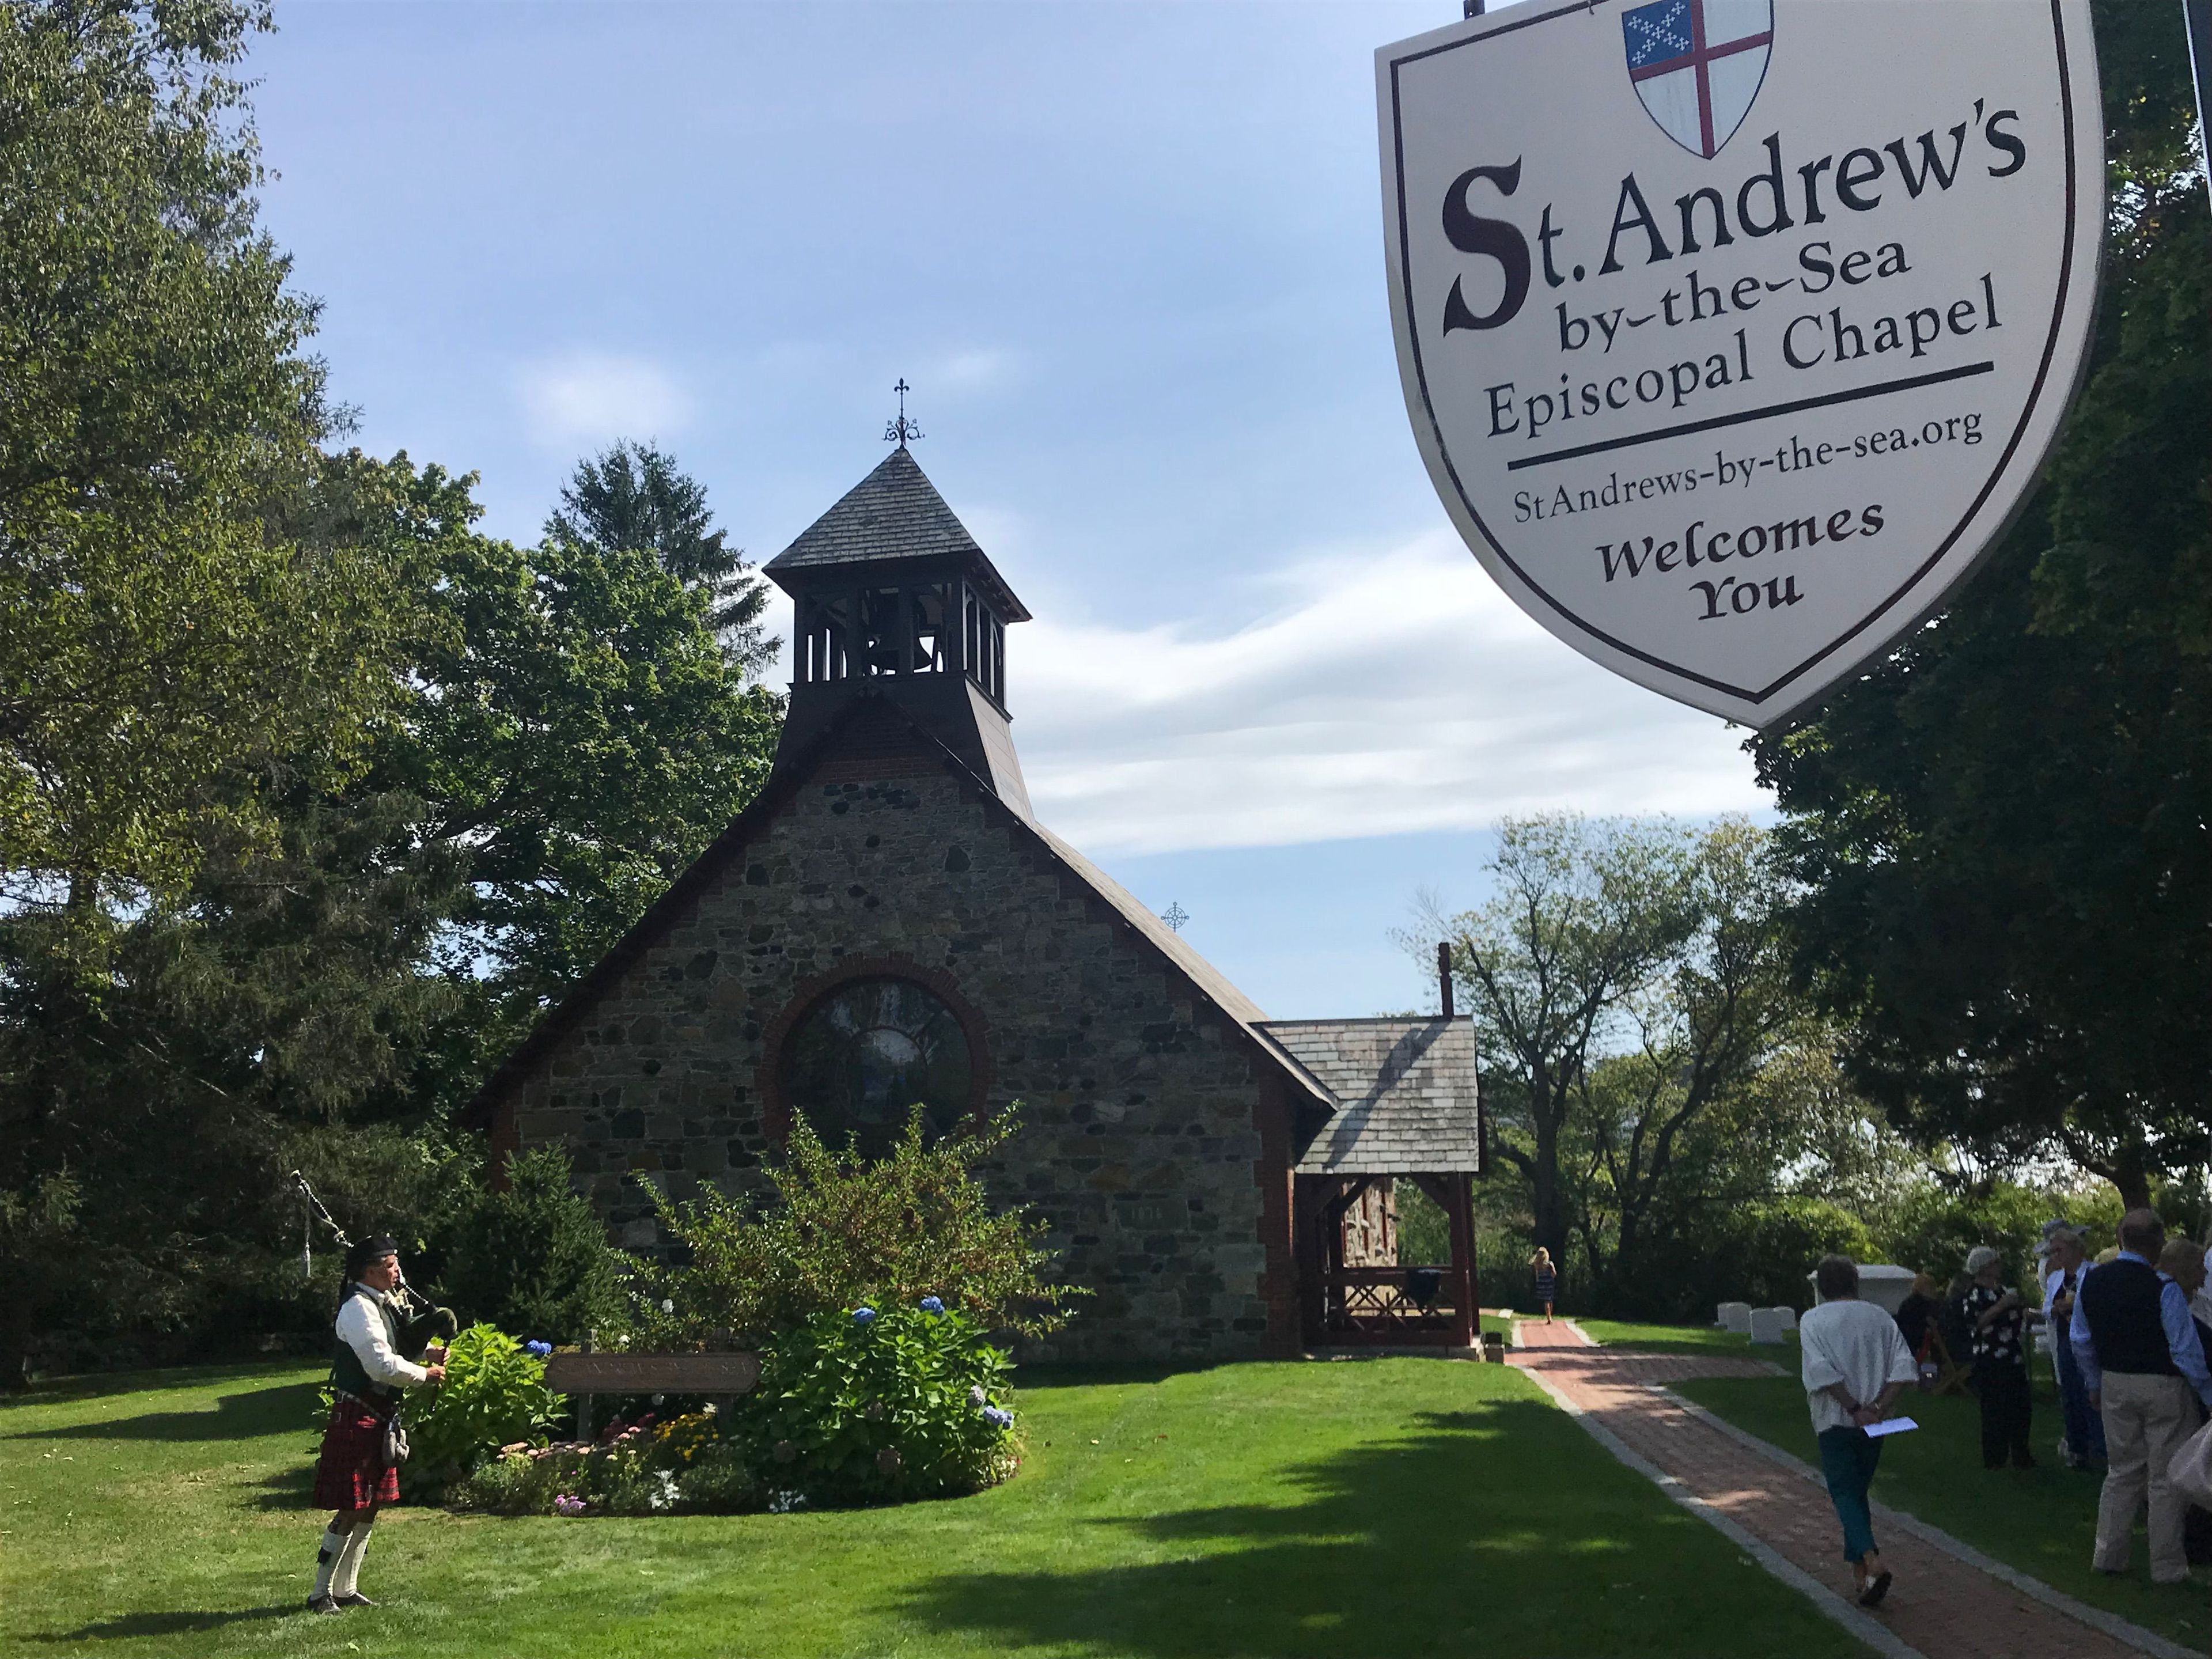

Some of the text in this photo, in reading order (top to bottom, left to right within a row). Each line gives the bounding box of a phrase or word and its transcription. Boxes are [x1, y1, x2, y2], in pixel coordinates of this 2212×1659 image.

[1442, 97, 2027, 339] St. Andrew's
[1554, 241, 1913, 353] by-the-Sea
[1483, 272, 2003, 440] Episcopal Chapel
[1513, 412, 1983, 523] StAndrews-by-the-sea.org
[1594, 503, 1885, 583] Welcomes
[1688, 575, 1805, 621] You
